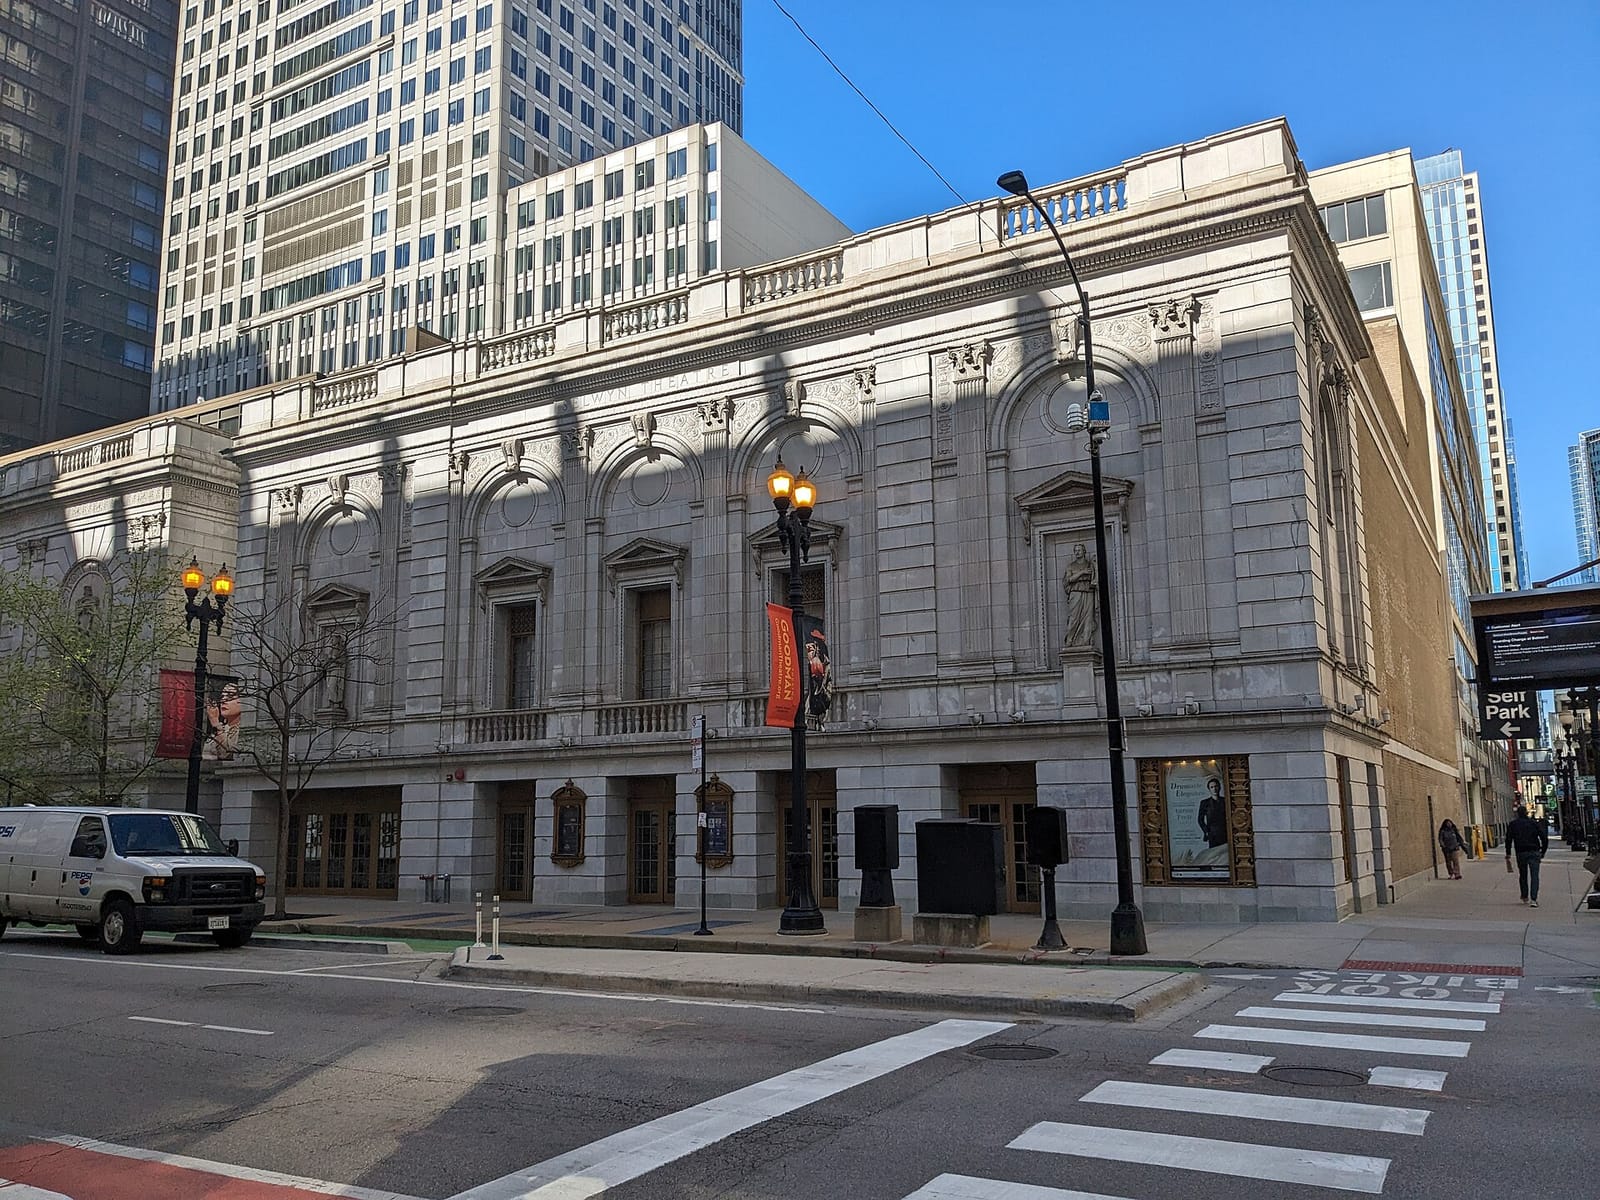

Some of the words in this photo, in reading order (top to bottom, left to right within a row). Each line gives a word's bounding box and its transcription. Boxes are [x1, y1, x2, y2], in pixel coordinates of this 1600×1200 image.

[562, 386, 627, 411] SELWYN
[641, 364, 730, 394] THEATRE
[781, 619, 792, 700] GOODMAN
[1485, 703, 1531, 720] Park
[71, 871, 93, 880] PEPSI
[1292, 970, 1519, 989] BIKES
[1282, 981, 1505, 1003] LOOK
